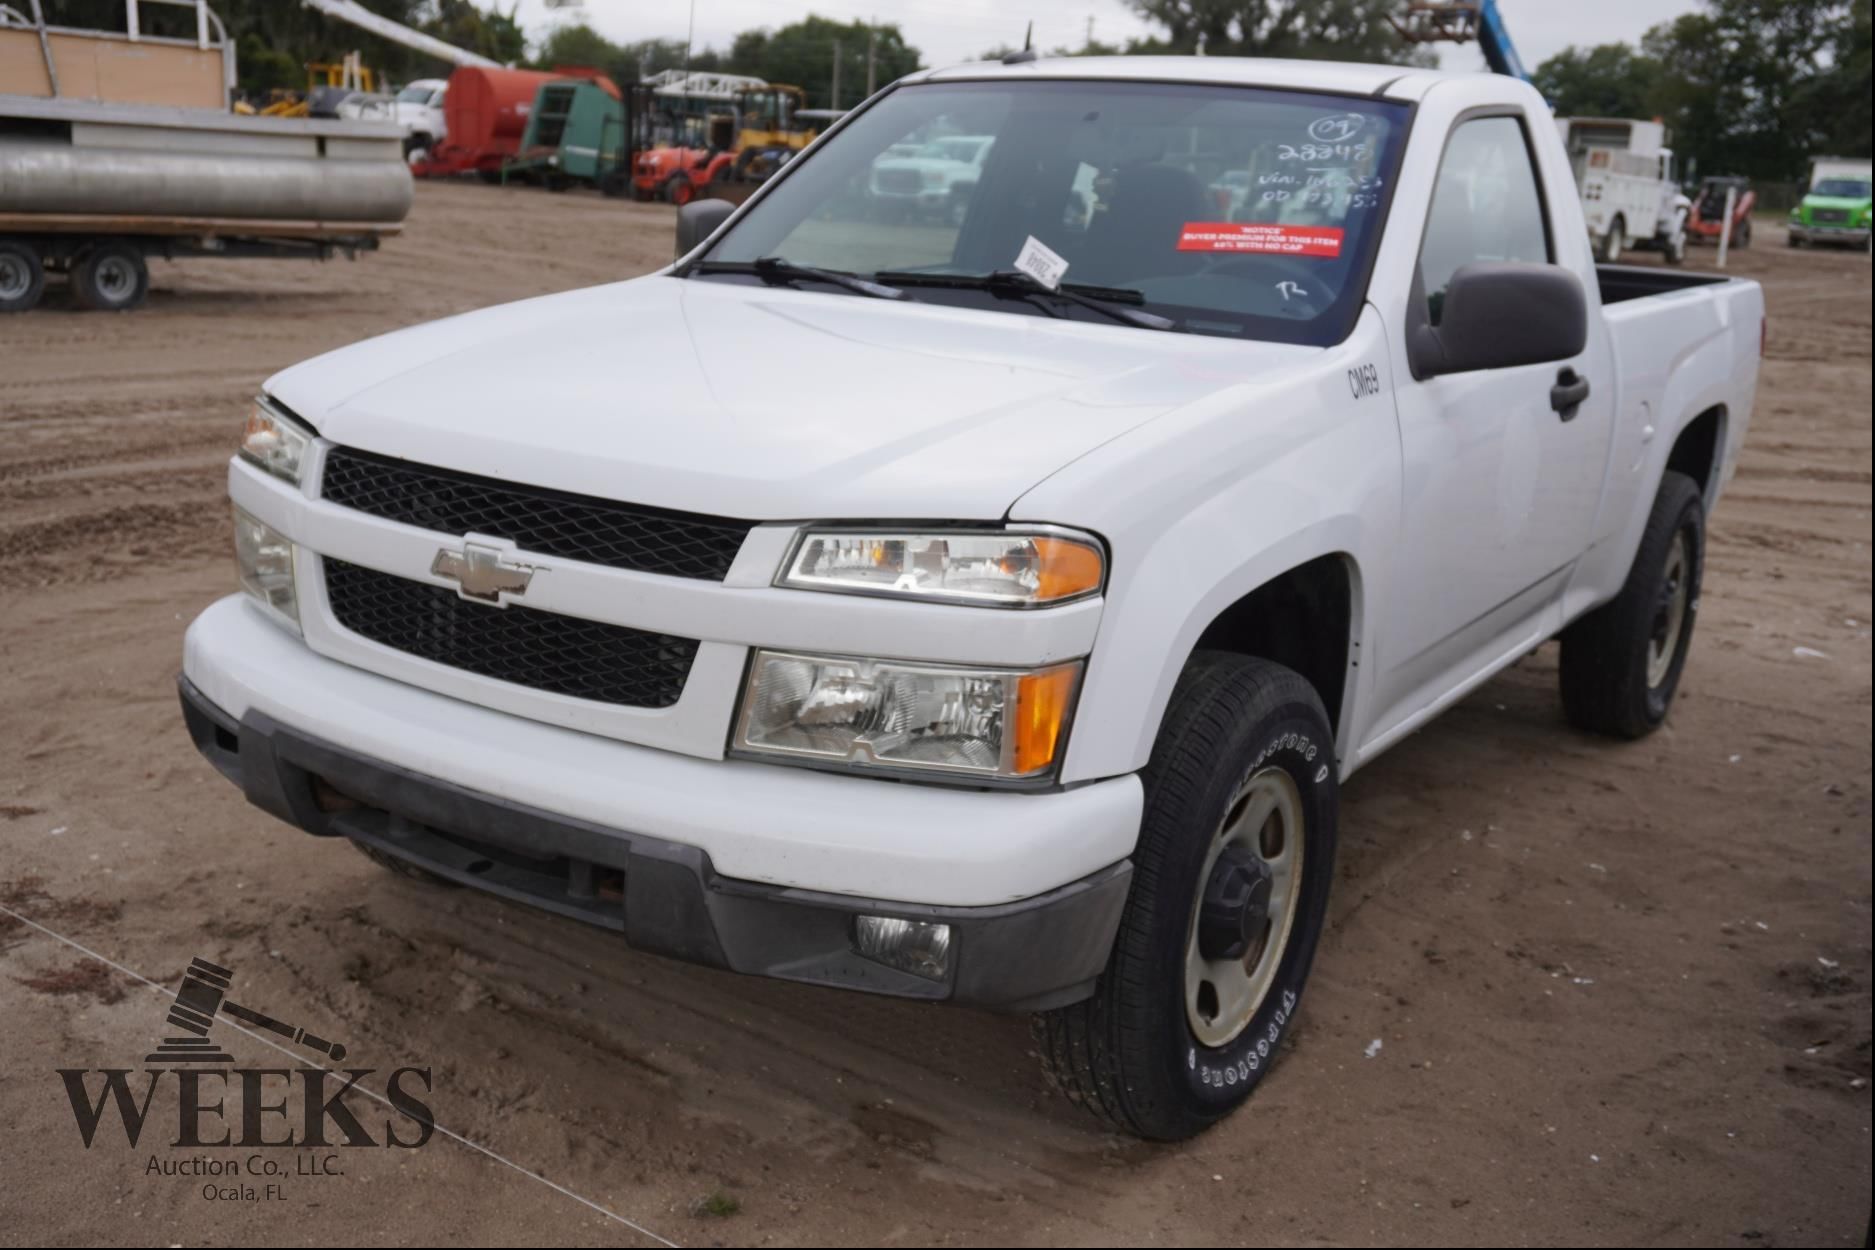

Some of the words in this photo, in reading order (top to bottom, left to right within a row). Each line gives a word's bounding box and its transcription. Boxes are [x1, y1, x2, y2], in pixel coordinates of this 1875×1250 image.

[1183, 233, 1217, 241] BUYER
[1218, 233, 1265, 242] PREMIUM
[1267, 235, 1287, 243] FOR
[1289, 236, 1312, 244] THIS
[1313, 237, 1339, 246] ITEM
[1265, 242, 1281, 250] NO
[1282, 243, 1304, 251] CAP
[1348, 363, 1380, 399] CM69
[1200, 990, 1297, 1088] Firestone
